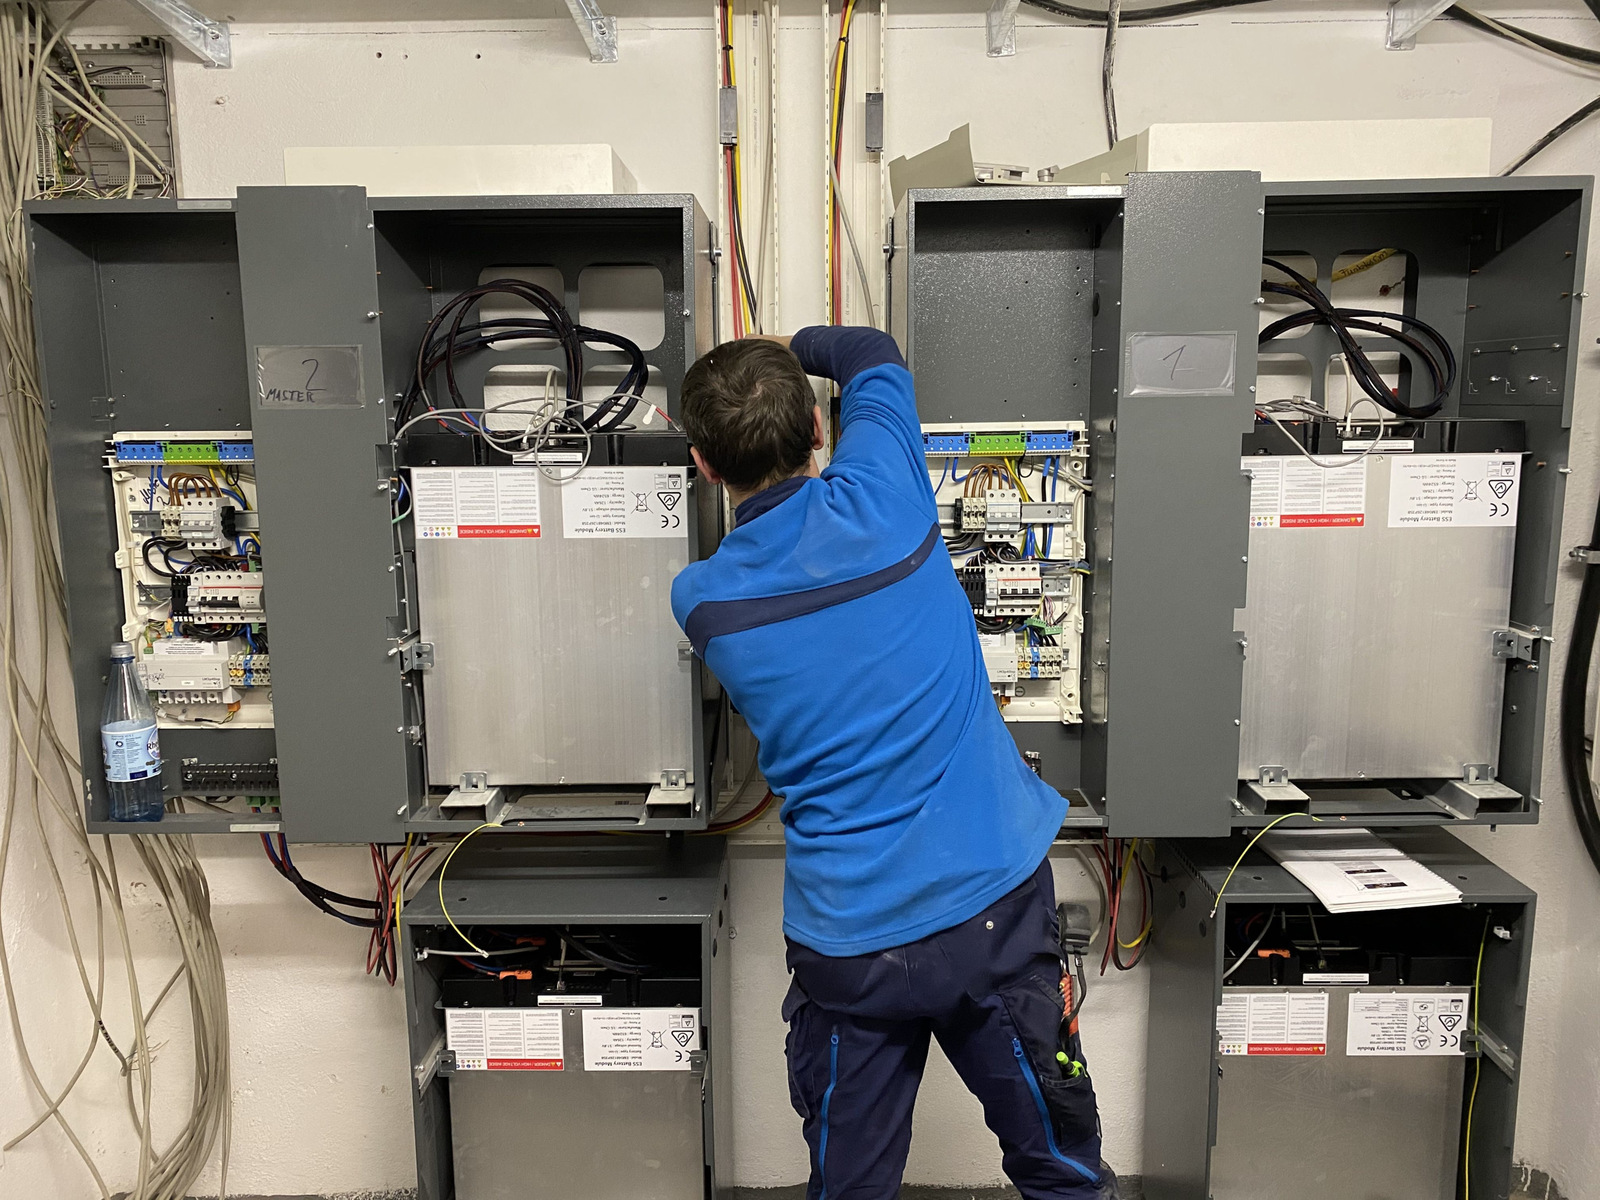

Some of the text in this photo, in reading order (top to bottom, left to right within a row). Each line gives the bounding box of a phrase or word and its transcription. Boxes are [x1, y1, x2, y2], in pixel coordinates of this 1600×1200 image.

[302, 358, 327, 391] 2
[1163, 344, 1186, 380] 1
[266, 388, 315, 402] MASTER
